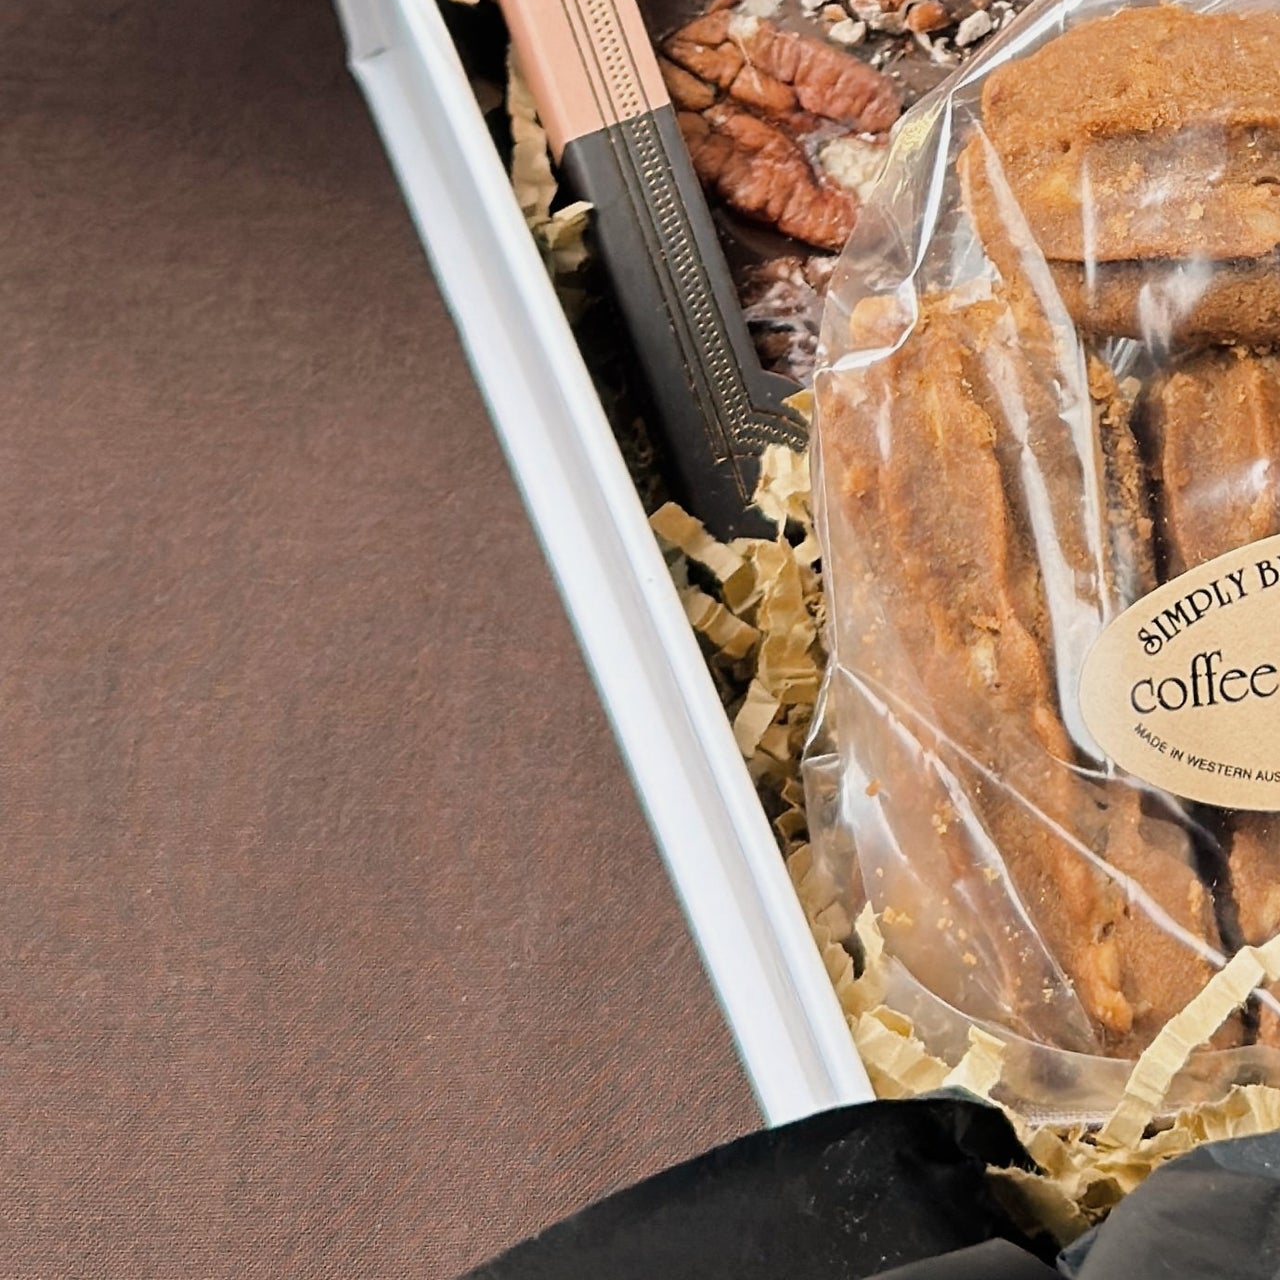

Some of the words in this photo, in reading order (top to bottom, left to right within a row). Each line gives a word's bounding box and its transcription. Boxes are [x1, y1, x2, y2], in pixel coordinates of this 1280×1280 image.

[1138, 568, 1250, 656] SIMPLY
[1130, 649, 1280, 714] coffee
[1134, 723, 1168, 753] MADE
[1170, 747, 1185, 762] IN
[1187, 753, 1251, 780] WESTERN
